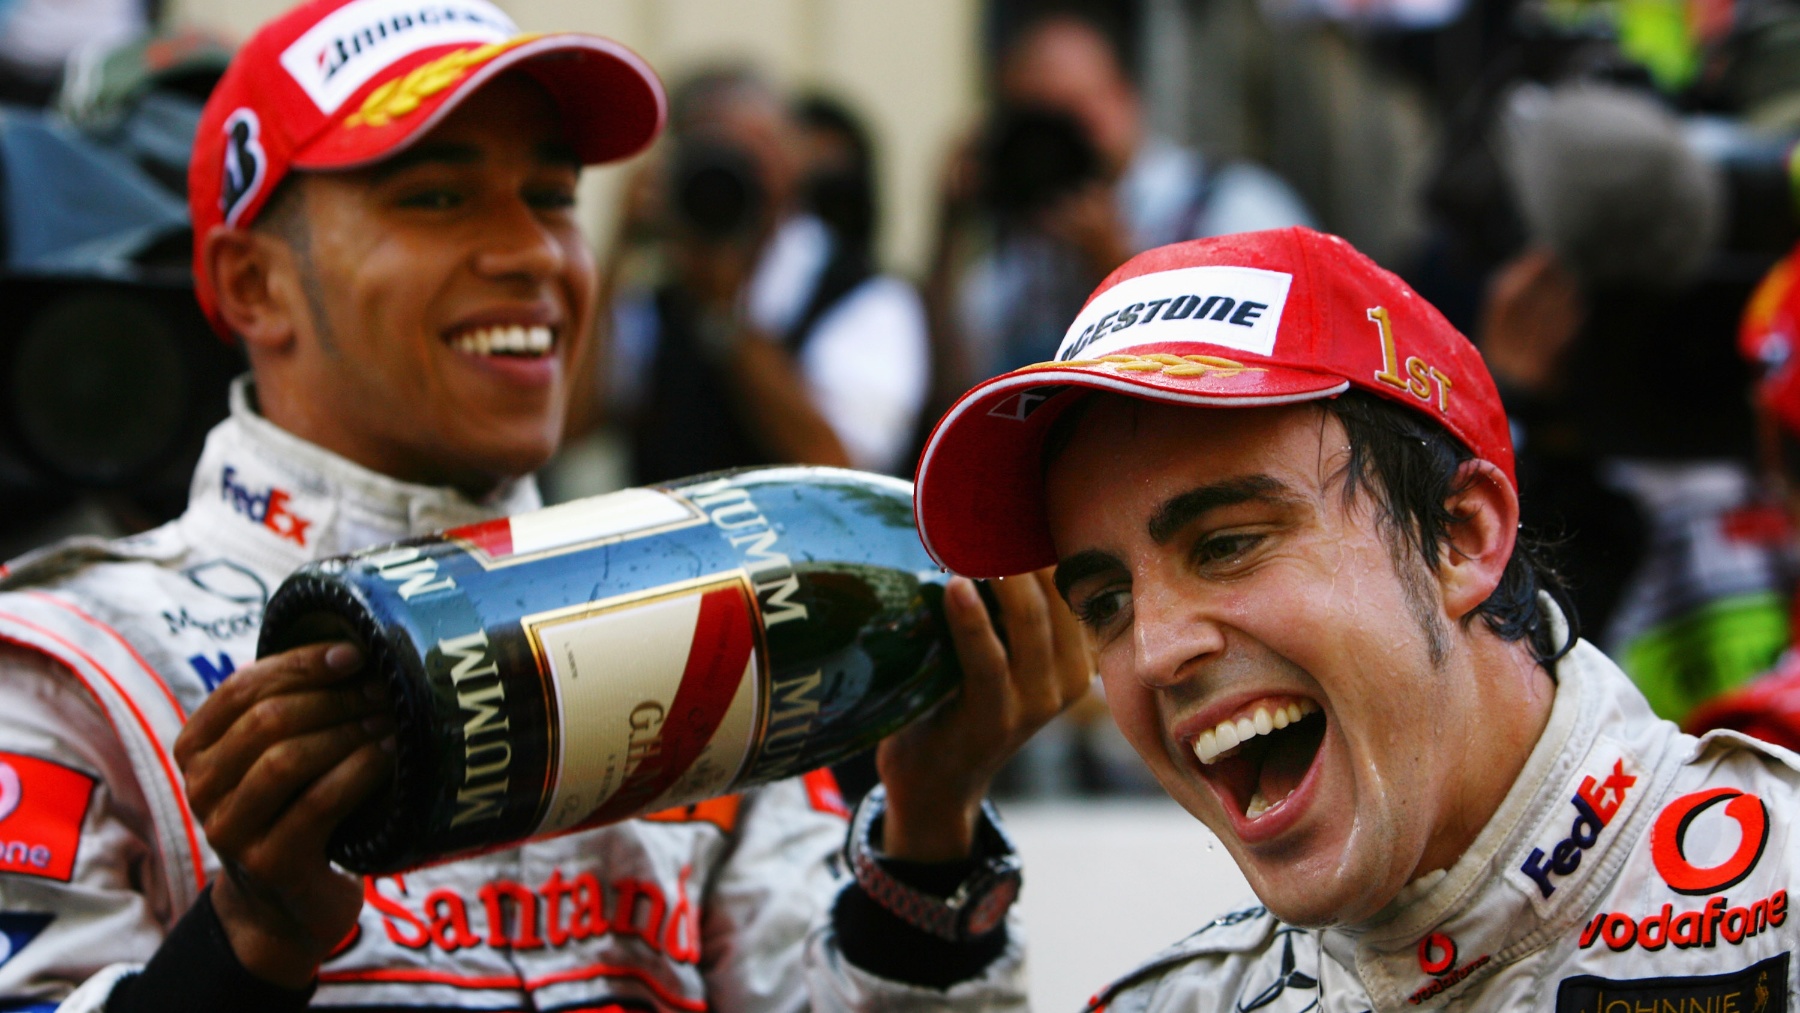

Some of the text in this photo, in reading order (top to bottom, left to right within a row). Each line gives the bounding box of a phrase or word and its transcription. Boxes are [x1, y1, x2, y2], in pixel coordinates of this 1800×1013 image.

[1367, 306, 1453, 414] 1ST
[221, 465, 311, 547] FedEx
[449, 627, 512, 828] MUMM
[1521, 757, 1637, 899] FedEx
[1578, 889, 1788, 952] vodafone
